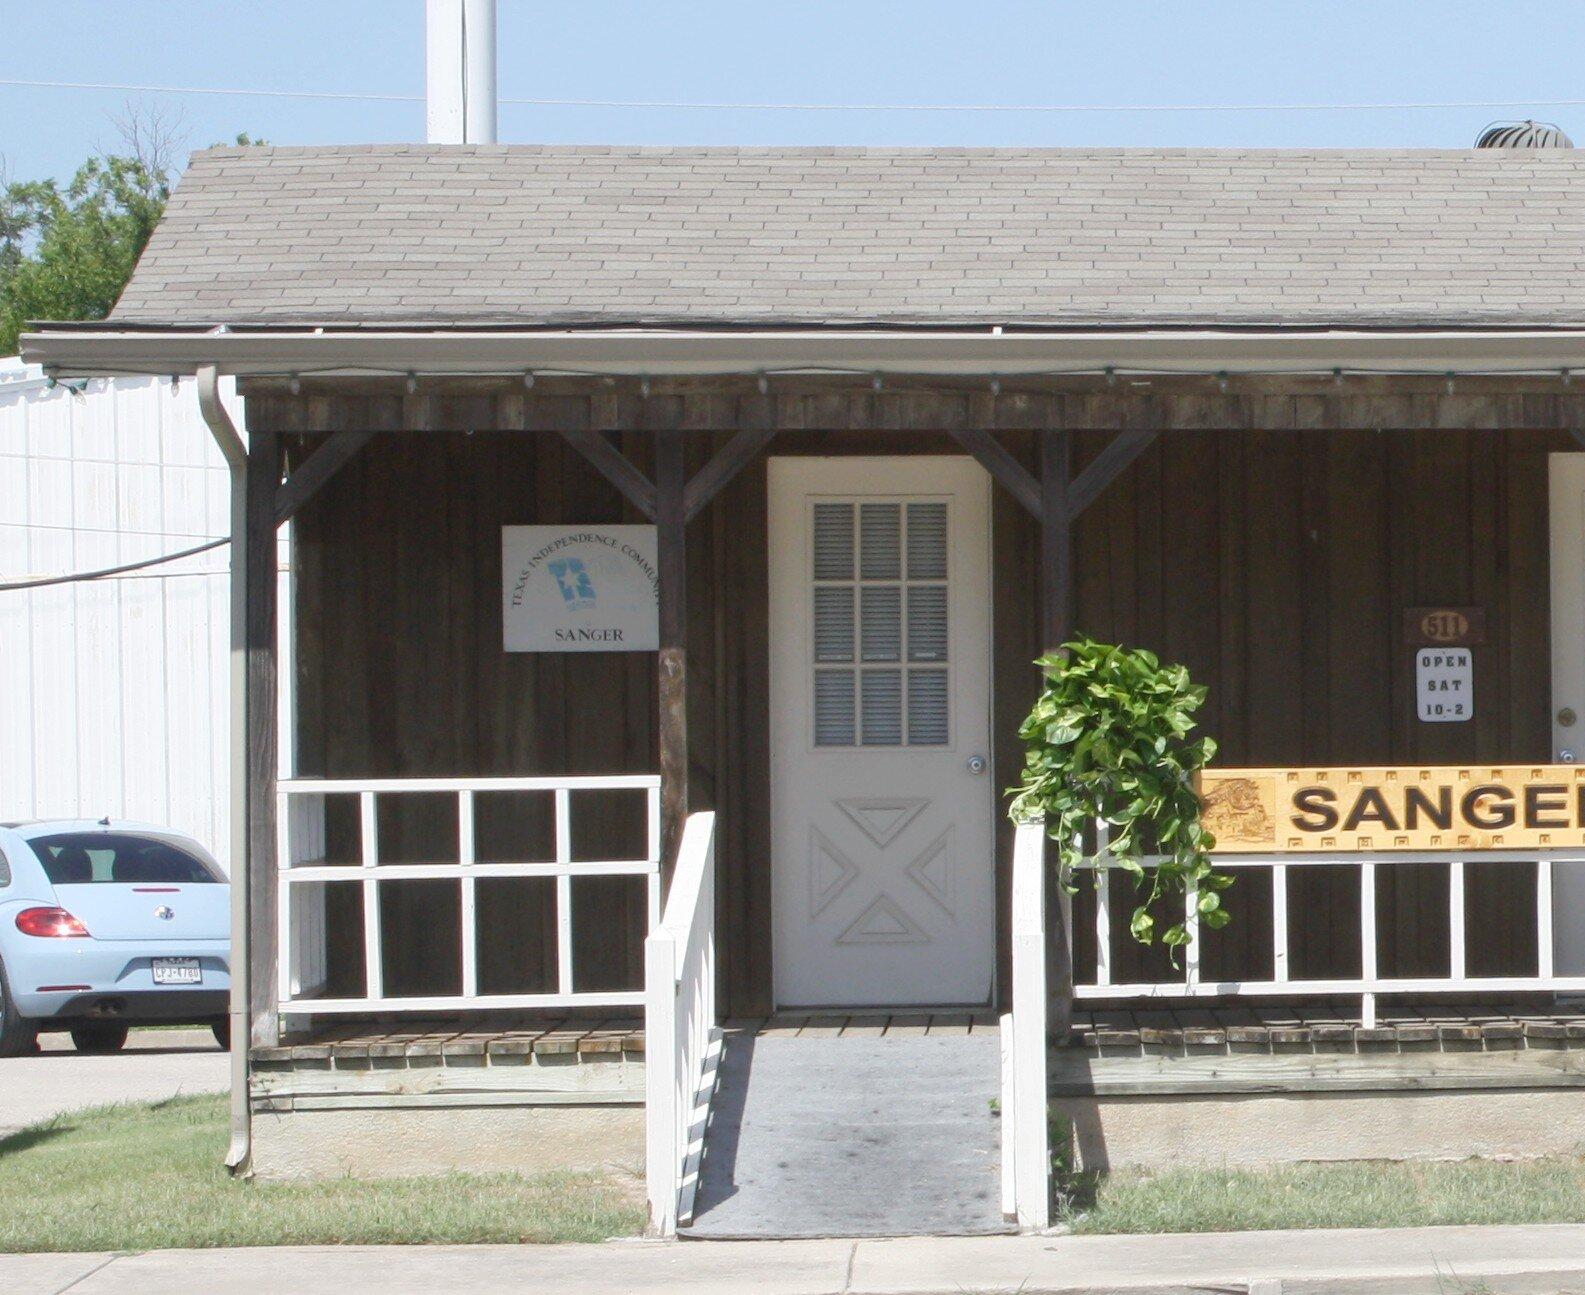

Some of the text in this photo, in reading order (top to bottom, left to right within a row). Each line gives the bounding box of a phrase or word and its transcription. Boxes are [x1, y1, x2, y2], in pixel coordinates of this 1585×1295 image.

[512, 533, 661, 606] TEXAS INDEPENDENCE COMMUN
[1427, 615, 1460, 638] 511
[554, 628, 624, 642] SANGER
[1422, 656, 1467, 668] OPEN
[1428, 680, 1462, 691] SAT
[1426, 704, 1463, 715] 10-2
